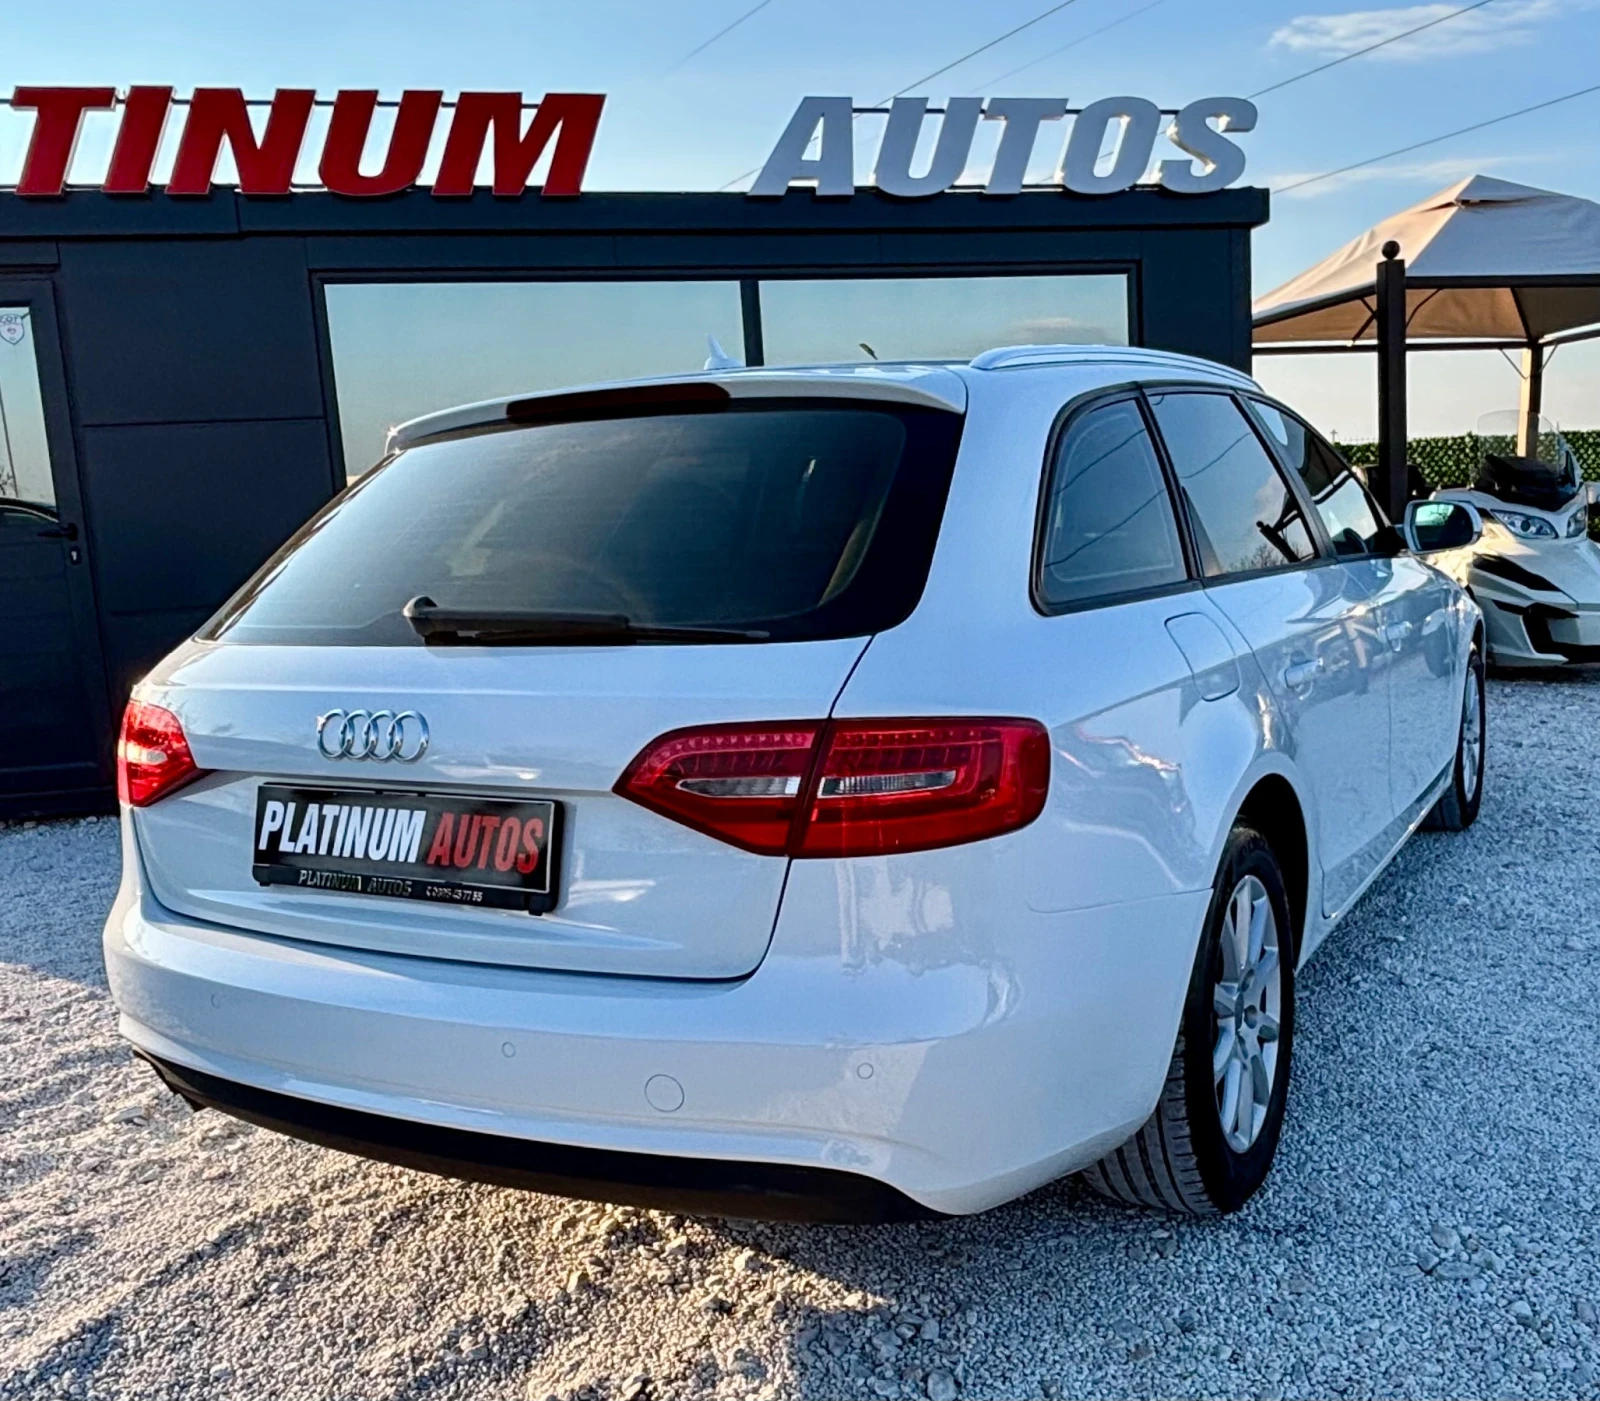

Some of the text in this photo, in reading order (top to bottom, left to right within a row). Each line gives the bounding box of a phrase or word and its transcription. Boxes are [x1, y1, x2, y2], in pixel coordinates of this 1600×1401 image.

[13, 85, 1258, 197] TINUM AUTOS
[258, 800, 544, 874] PLATINUM AUTOS
[298, 869, 362, 891] PLATINUM
[366, 877, 413, 897] AUTOS
